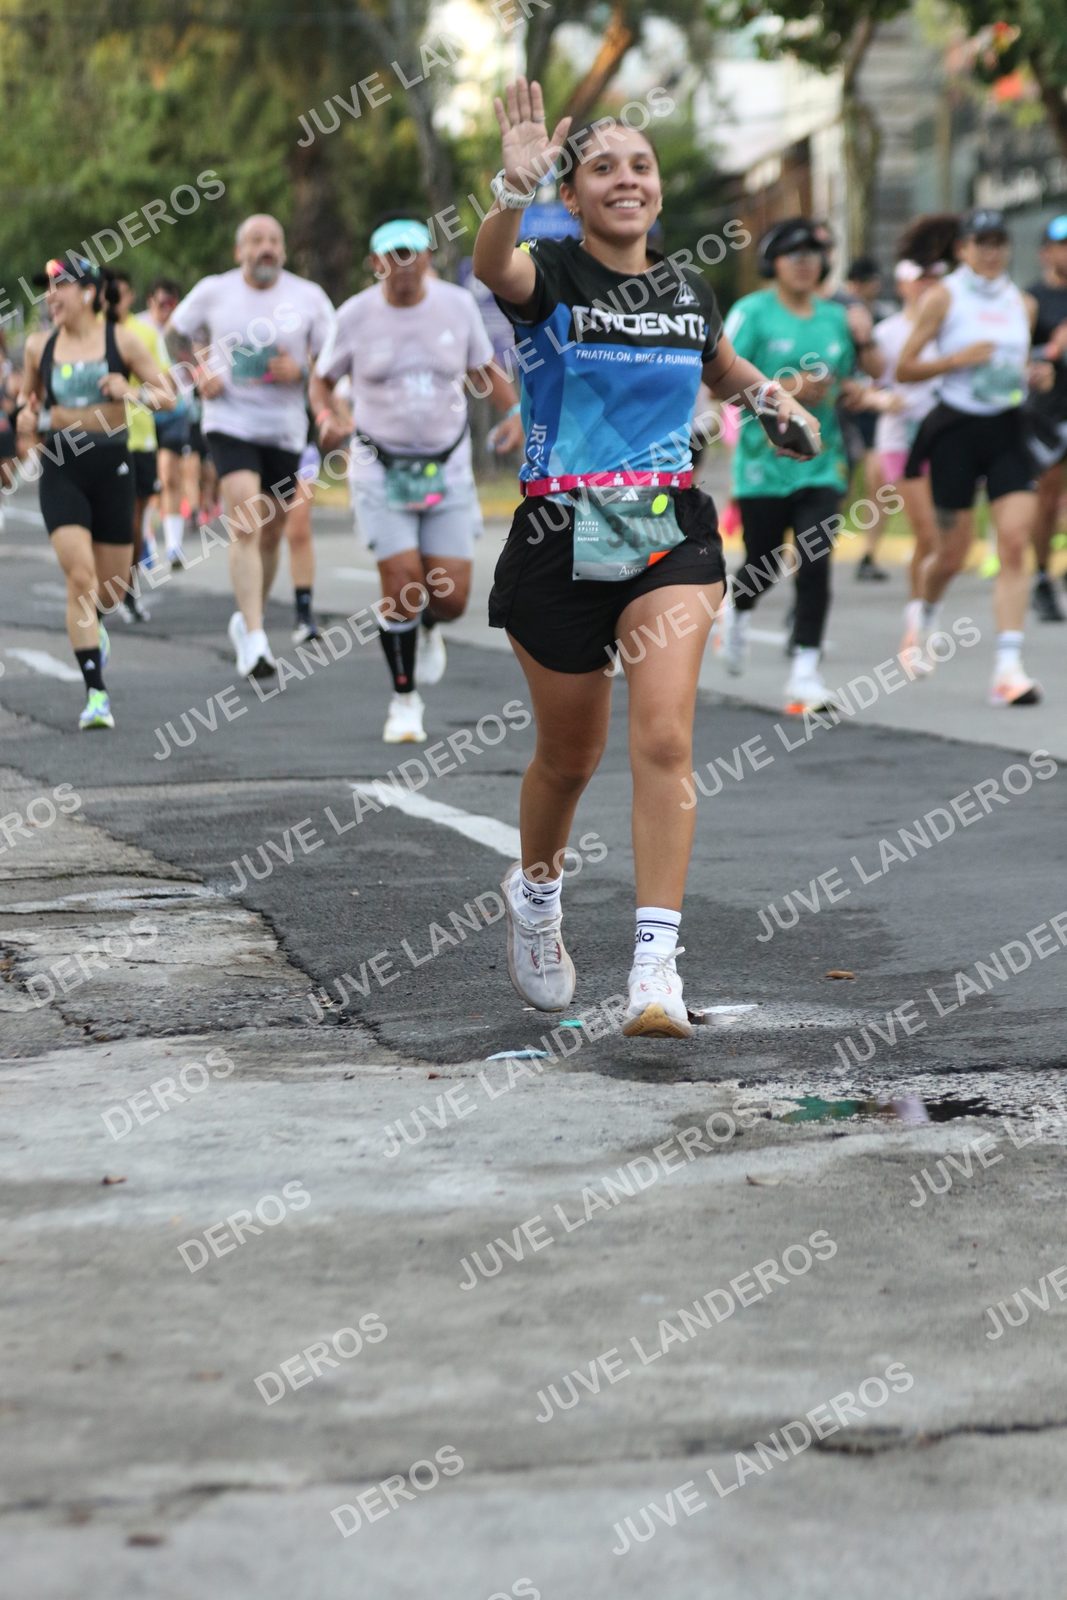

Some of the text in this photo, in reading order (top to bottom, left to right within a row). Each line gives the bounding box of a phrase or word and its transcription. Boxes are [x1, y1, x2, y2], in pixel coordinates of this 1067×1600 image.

[575, 349, 633, 363] TRIATHLON,
[635, 353, 656, 363] BIKE
[656, 354, 664, 364] &
